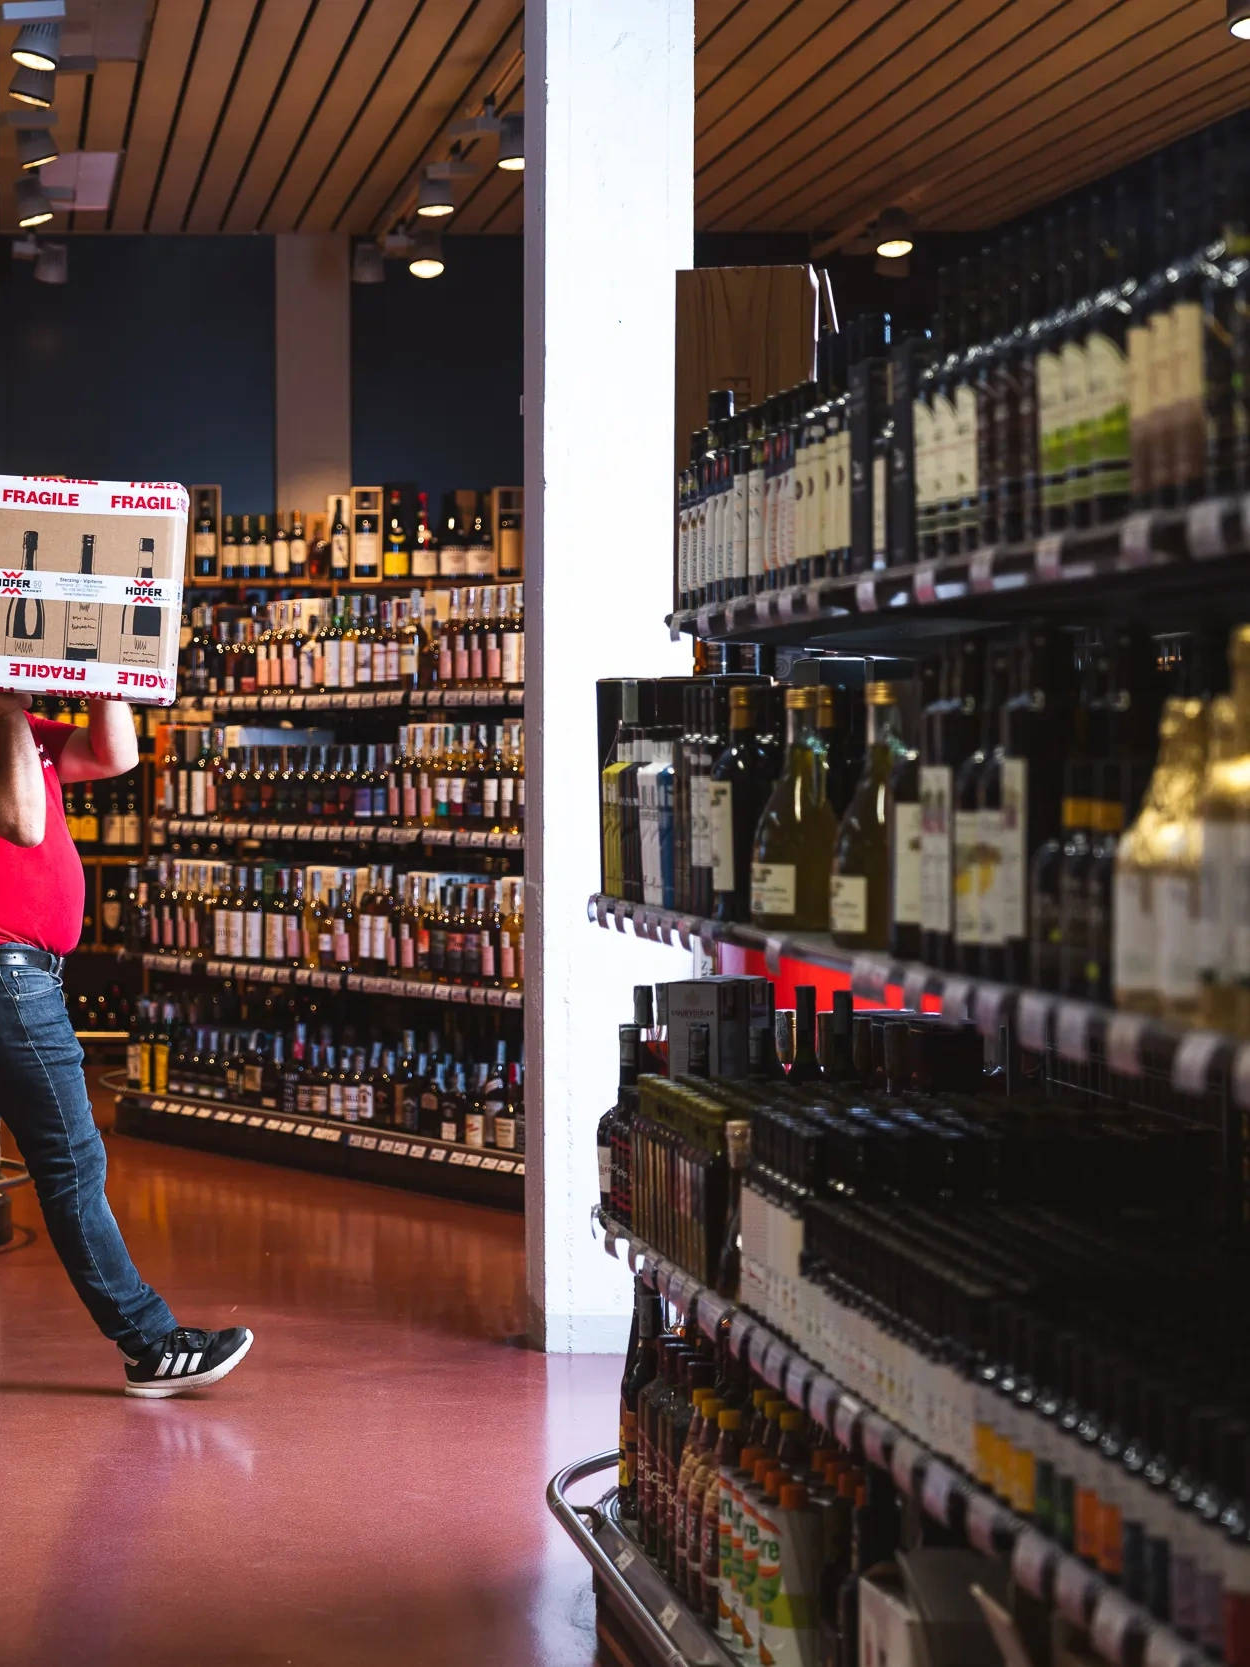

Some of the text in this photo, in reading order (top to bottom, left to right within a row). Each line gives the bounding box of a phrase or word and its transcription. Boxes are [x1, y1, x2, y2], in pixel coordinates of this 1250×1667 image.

[2, 489, 80, 507] FRAGILE
[125, 586, 163, 597] HOFER
[9, 662, 86, 681] FRAGILE
